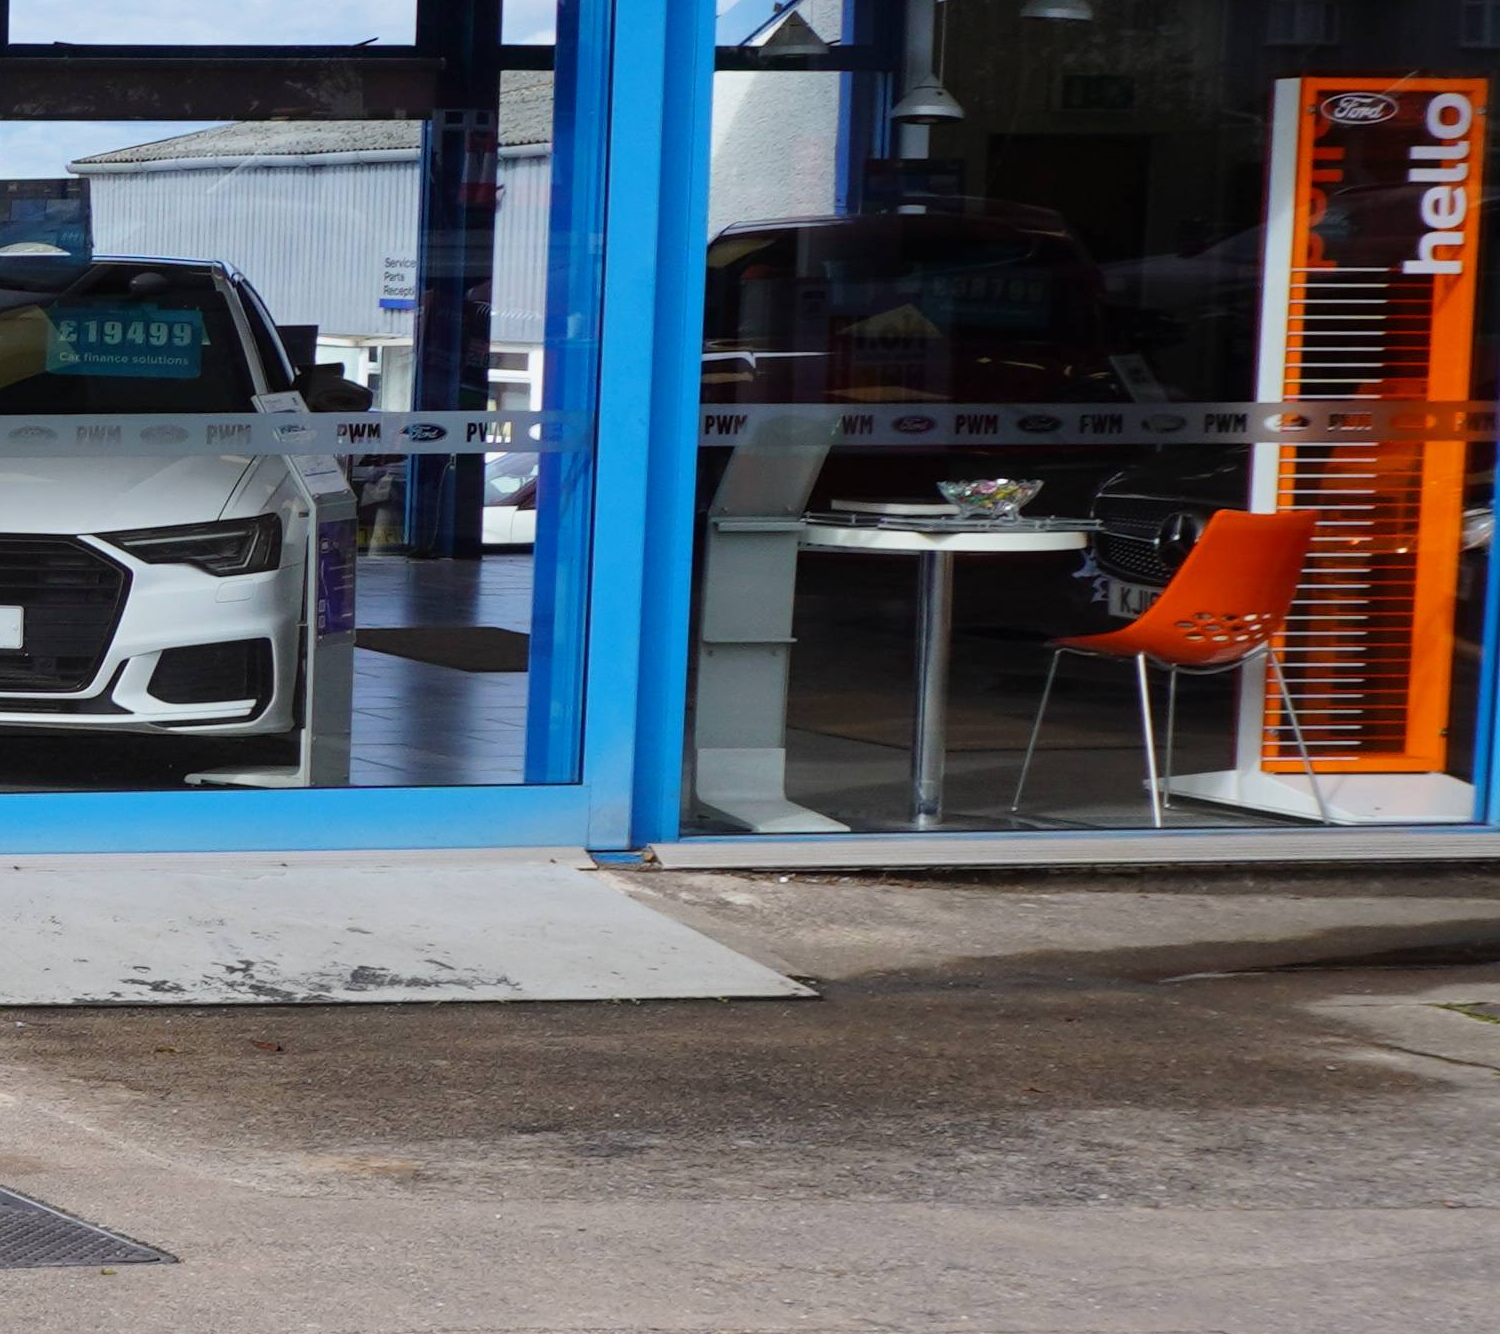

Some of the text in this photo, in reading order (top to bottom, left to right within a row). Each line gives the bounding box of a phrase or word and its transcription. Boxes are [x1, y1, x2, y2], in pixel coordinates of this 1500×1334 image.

[1402, 91, 1472, 275] hello
[384, 271, 405, 281] Parts
[59, 318, 193, 347] £19499
[59, 352, 189, 365] Car finance solutions
[76, 425, 122, 445] PWM
[206, 424, 252, 445] PWM
[336, 423, 382, 444] PWM
[466, 422, 512, 443] PWM
[705, 415, 748, 435] PWM
[955, 414, 998, 435] PWM
[1204, 413, 1247, 434] PWM
